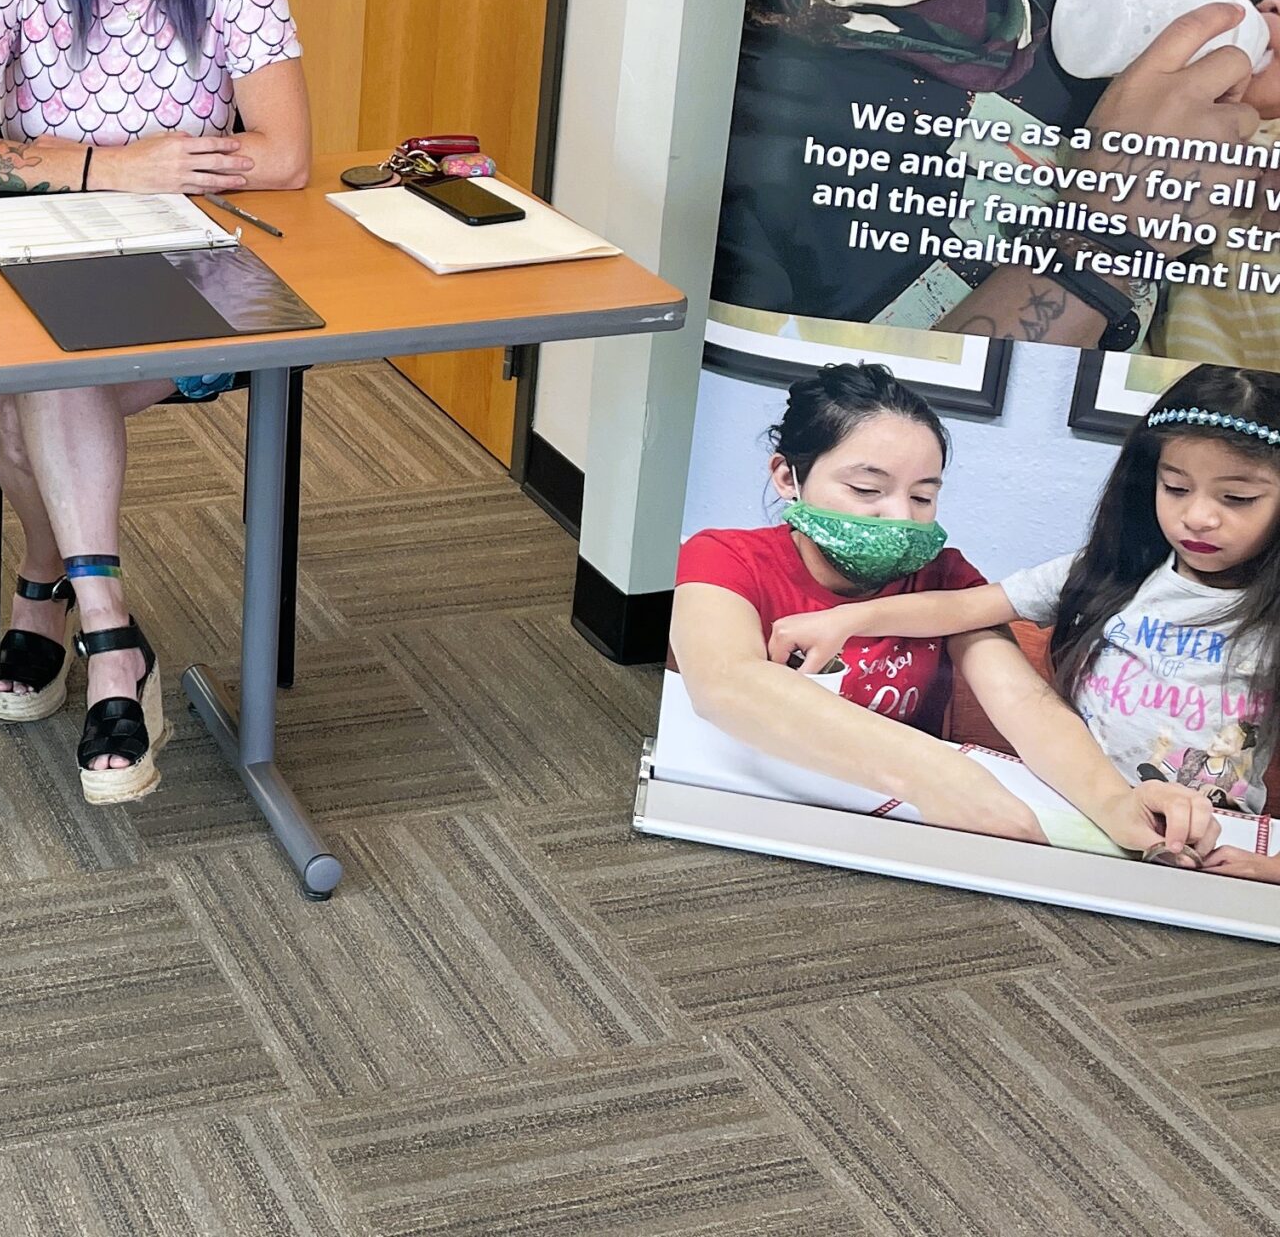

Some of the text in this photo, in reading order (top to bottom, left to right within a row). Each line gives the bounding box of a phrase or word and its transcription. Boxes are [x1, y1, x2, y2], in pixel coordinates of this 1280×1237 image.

[850, 102, 1280, 170] We serve as a communi
[803, 137, 890, 172] hope
[900, 147, 966, 180] and
[976, 159, 1137, 202] recovery
[1145, 170, 1200, 202] for
[1209, 176, 1254, 208] all
[812, 181, 1280, 254] and their families who str
[848, 220, 1280, 294] live healthy, resilient liv
[1135, 616, 1225, 663] NEVER
[1084, 655, 1211, 731] ooking
